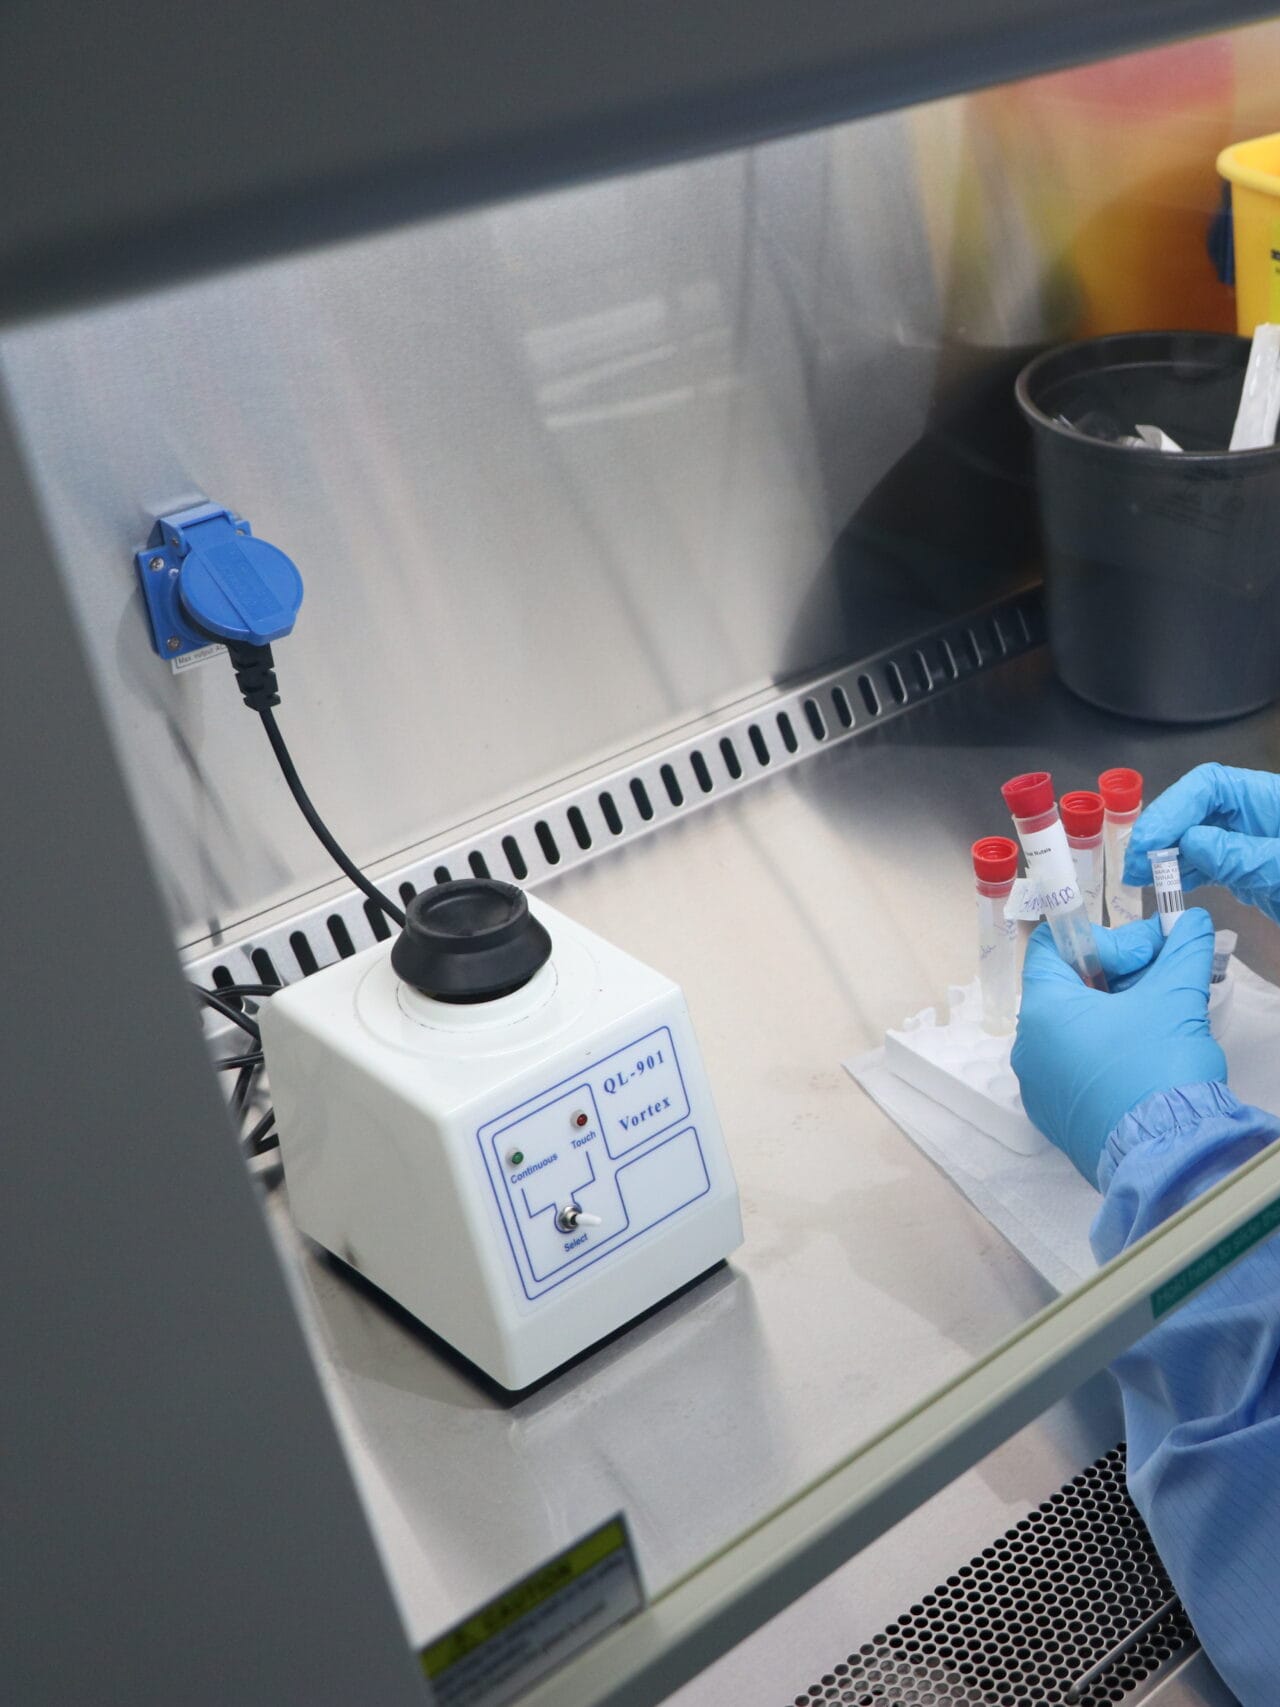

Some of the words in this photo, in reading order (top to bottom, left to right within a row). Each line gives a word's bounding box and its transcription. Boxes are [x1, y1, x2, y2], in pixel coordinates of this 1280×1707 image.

[603, 1050, 665, 1095] QL-901
[619, 1096, 672, 1132] Vortex
[571, 1130, 596, 1151] Touch
[510, 1152, 558, 1184] Continuous
[564, 1232, 588, 1253] Select
